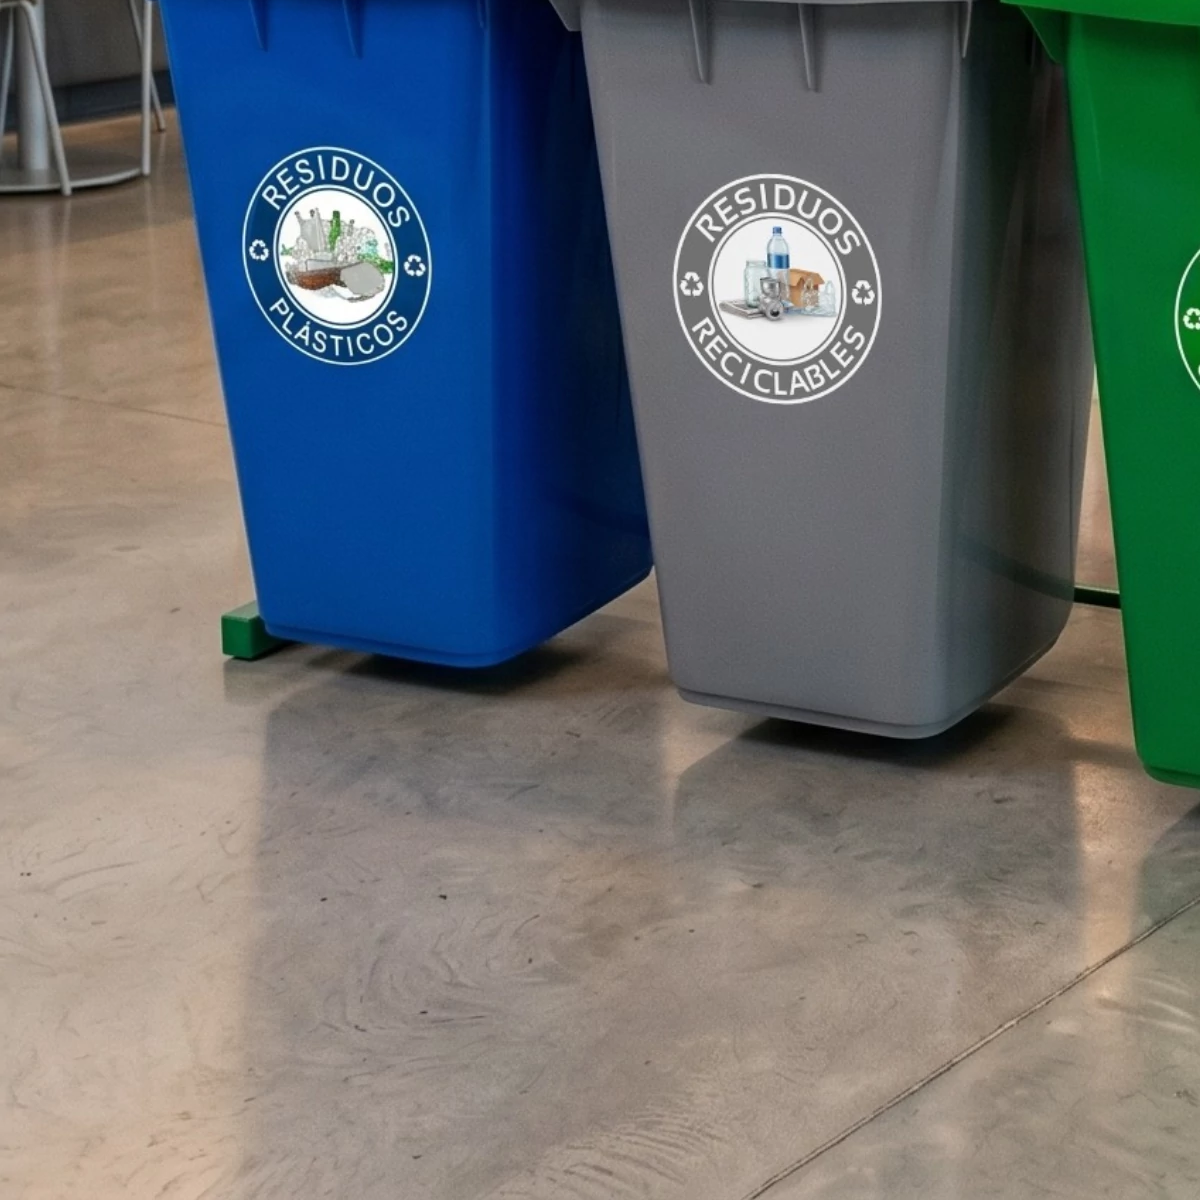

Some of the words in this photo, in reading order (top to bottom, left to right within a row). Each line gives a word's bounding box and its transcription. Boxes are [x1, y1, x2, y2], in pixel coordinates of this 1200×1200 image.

[261, 155, 410, 228] RESIDUOS
[695, 183, 861, 256] RESIDUOS
[269, 298, 408, 357] PLÁSTICOS
[692, 317, 865, 396] RECICLABLES
